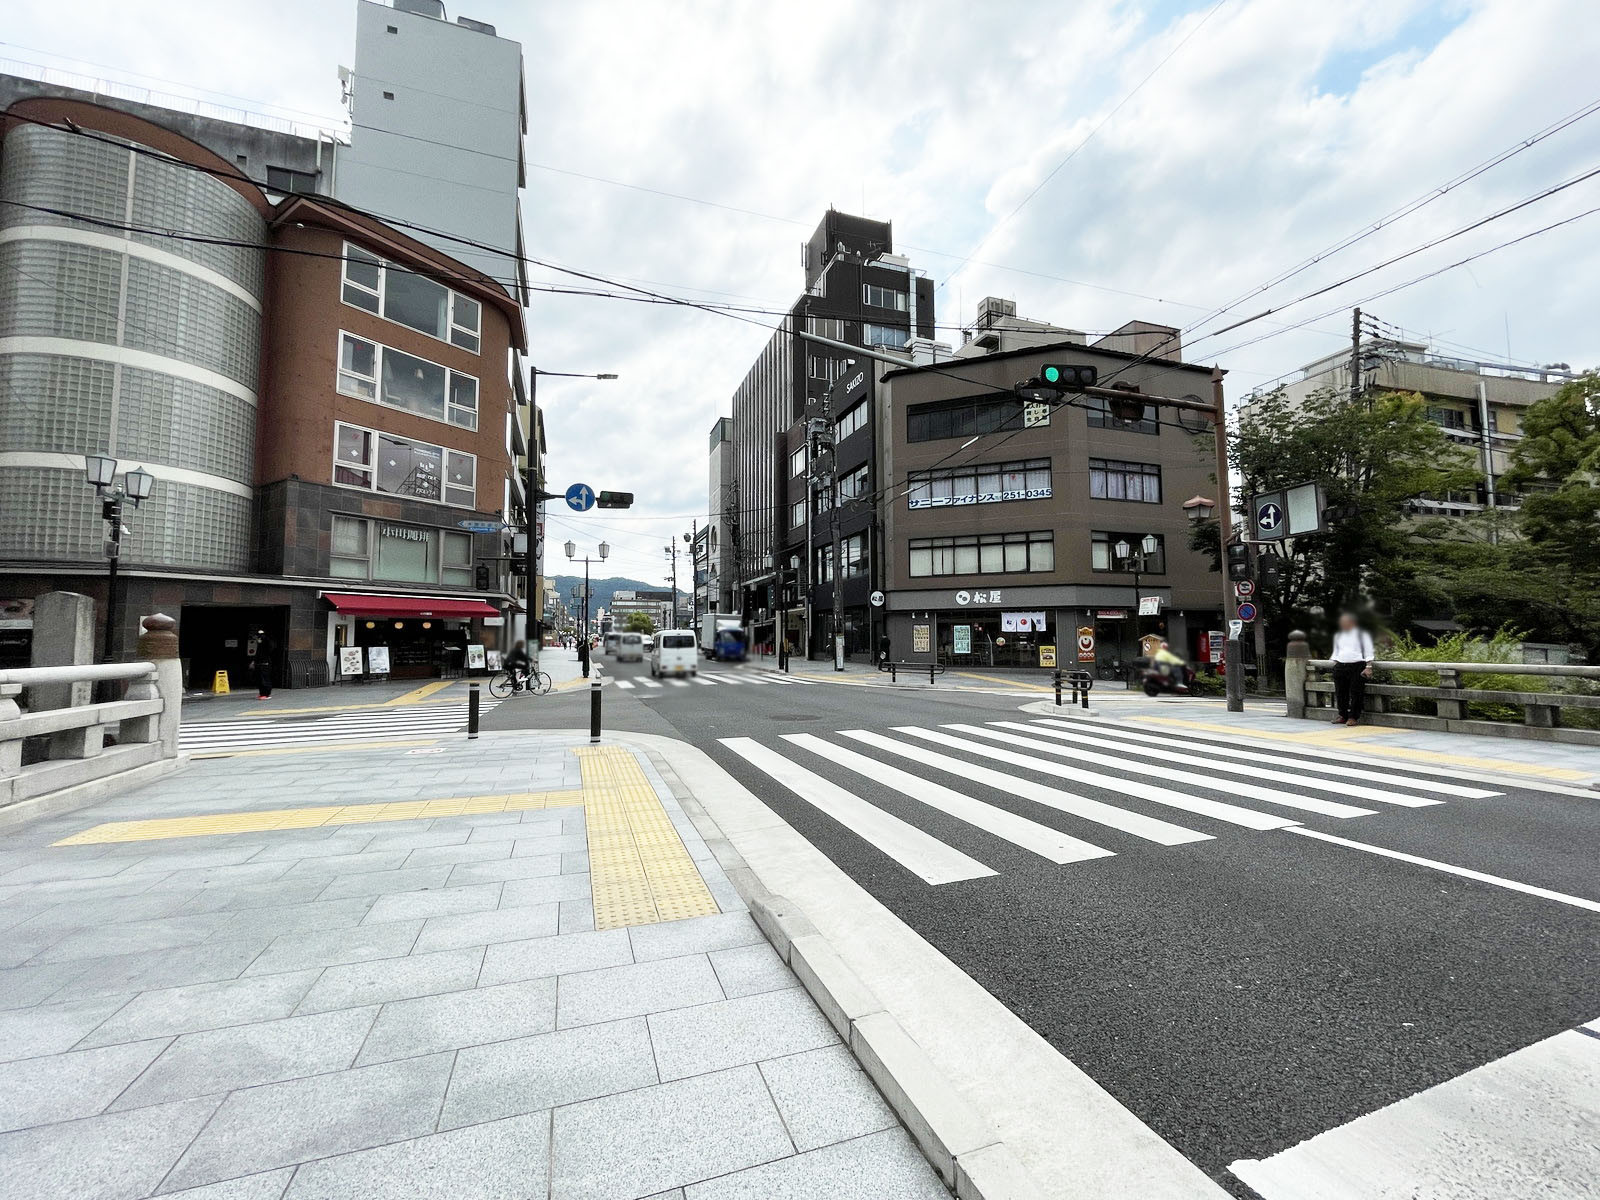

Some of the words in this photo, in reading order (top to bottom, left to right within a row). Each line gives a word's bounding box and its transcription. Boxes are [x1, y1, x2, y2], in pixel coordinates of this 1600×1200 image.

[909, 493, 995, 508] サニーファイナンス
[1003, 488, 1053, 499] 251-0345
[973, 590, 1002, 604] 松屋
